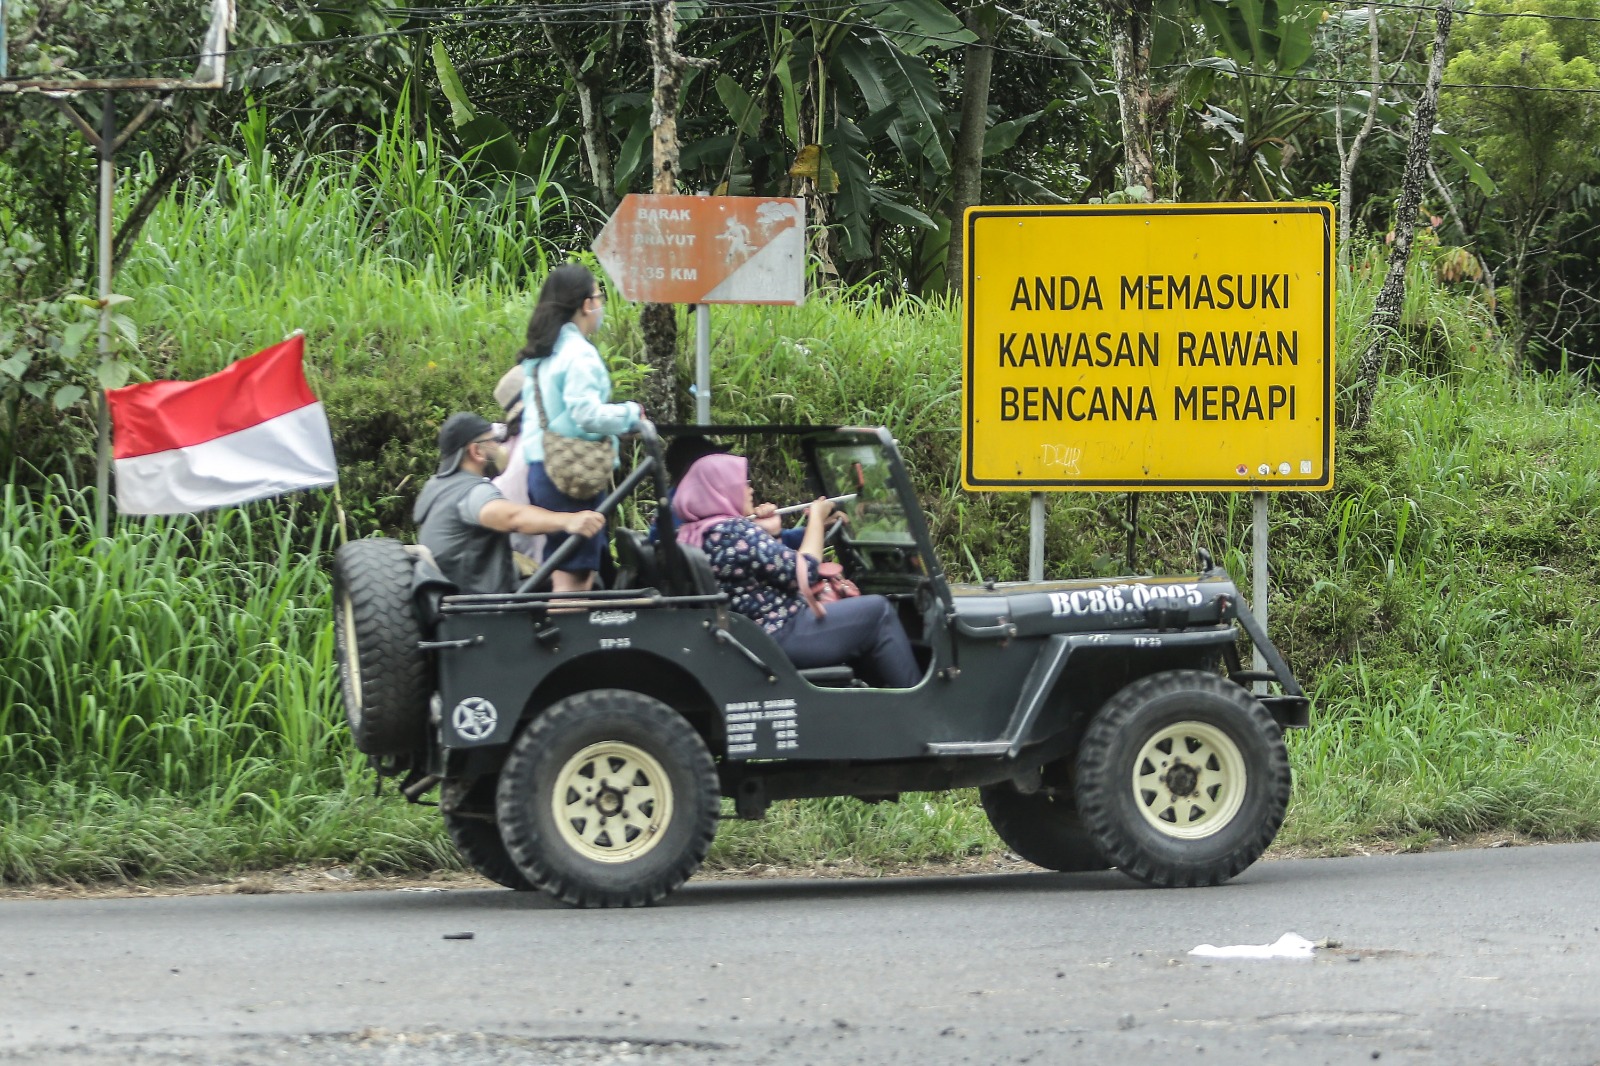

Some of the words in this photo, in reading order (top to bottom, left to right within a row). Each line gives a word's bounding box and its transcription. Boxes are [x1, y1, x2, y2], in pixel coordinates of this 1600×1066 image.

[637, 208, 691, 221] BARAK
[670, 267, 698, 281] KM
[1010, 275, 1104, 311] ANDA
[1120, 273, 1289, 310] MEMASUKI
[999, 331, 1159, 367] KAWASAN
[1177, 330, 1298, 367] RAWAN
[1000, 386, 1157, 422] BENCANA
[1174, 385, 1296, 421] MERAPI
